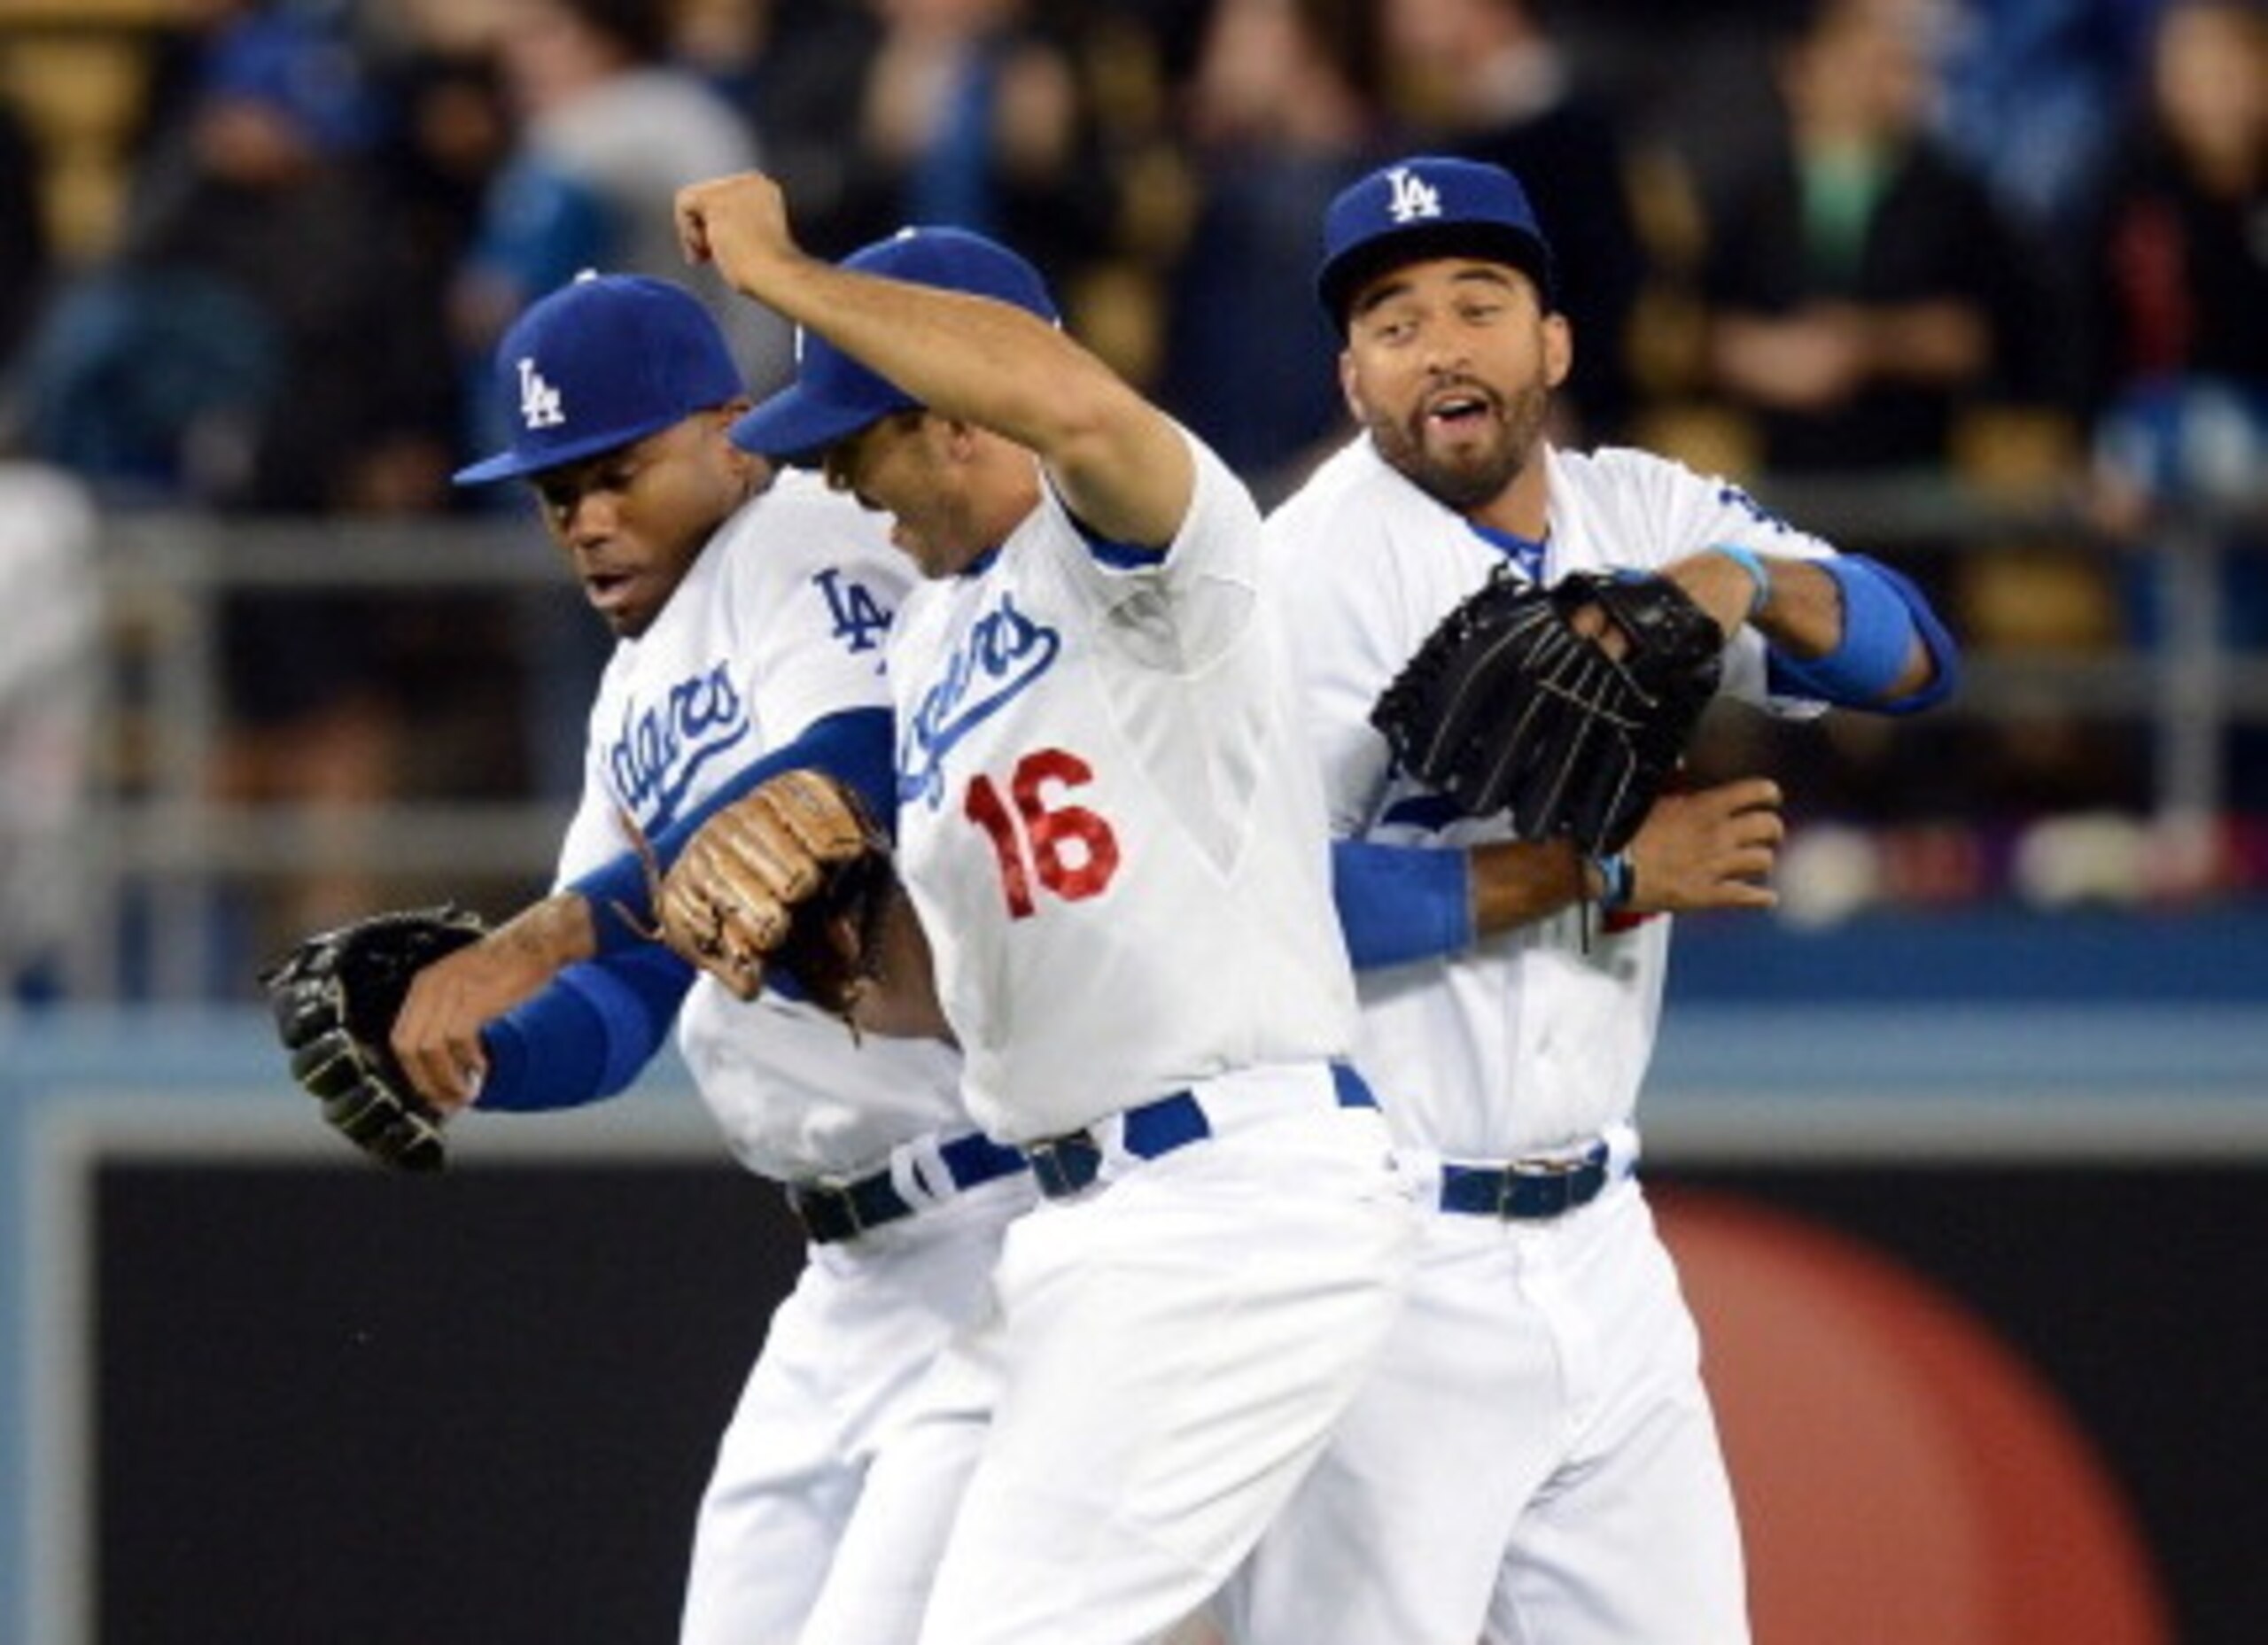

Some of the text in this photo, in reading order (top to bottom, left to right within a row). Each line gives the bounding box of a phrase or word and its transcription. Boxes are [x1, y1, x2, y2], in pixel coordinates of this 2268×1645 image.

[1386, 166, 1442, 222] LA
[517, 357, 565, 429] LA
[812, 567, 894, 654] LA
[964, 748, 1120, 922] 16
